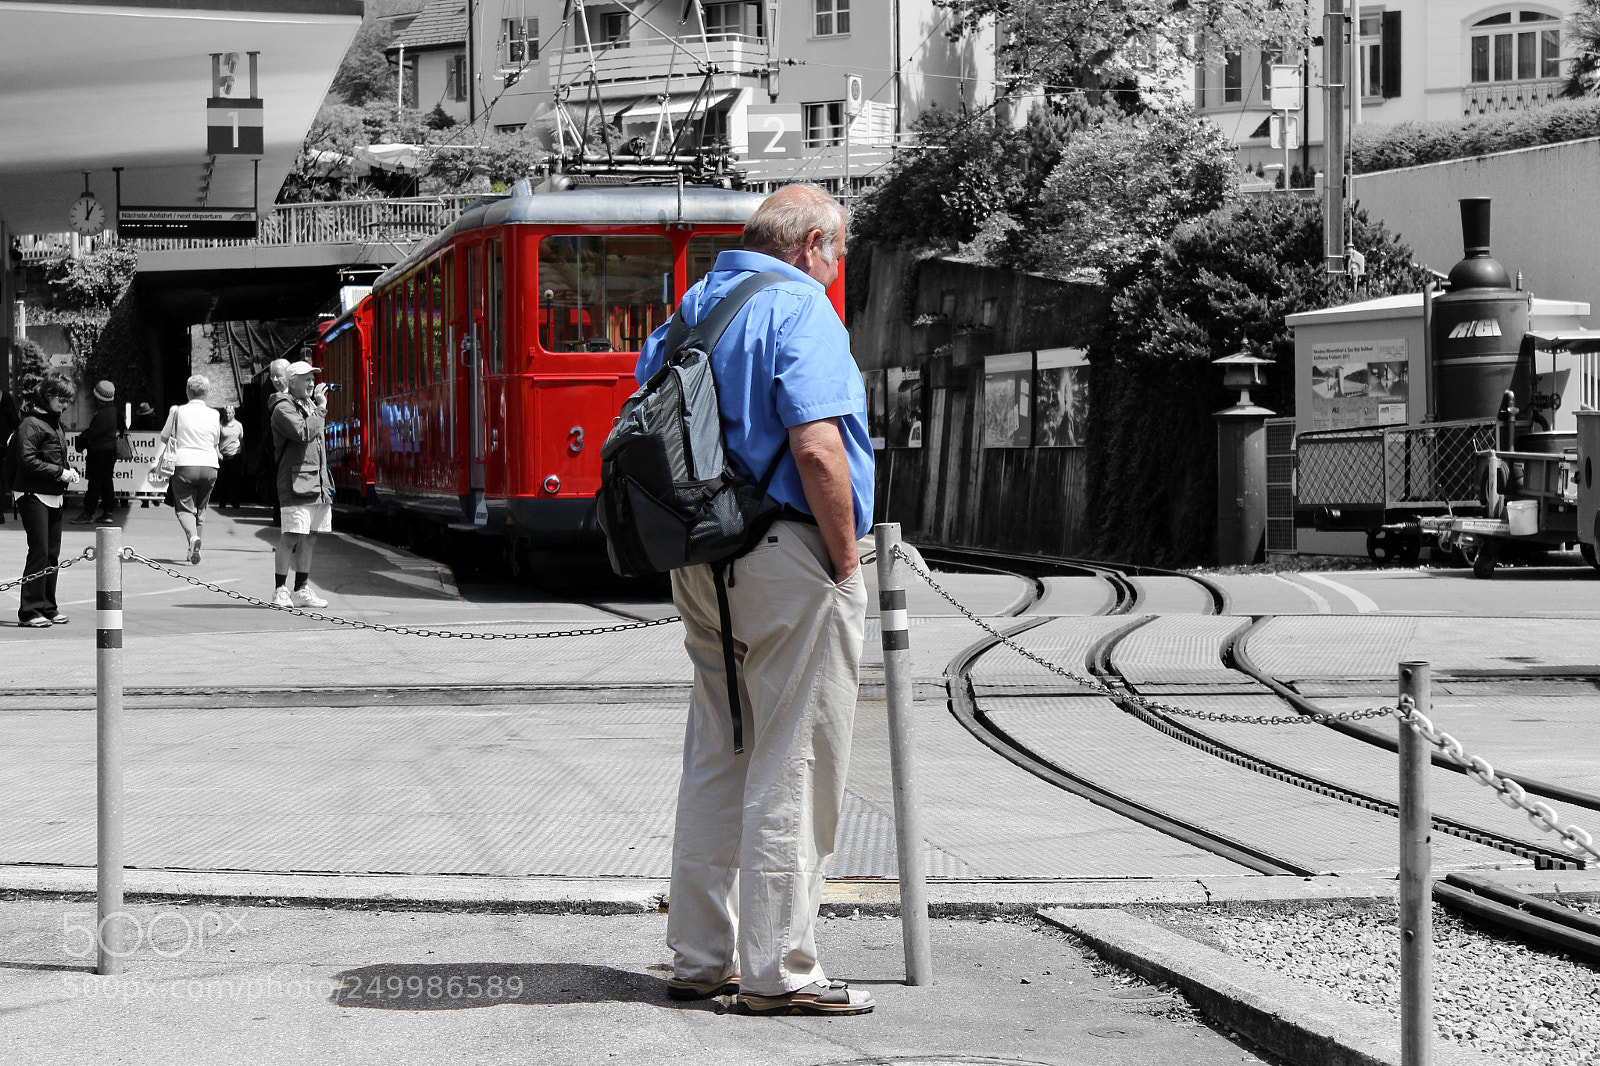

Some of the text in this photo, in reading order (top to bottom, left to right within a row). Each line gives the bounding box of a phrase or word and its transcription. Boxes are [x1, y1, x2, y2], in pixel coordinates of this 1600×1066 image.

[227, 112, 239, 148] 1
[763, 116, 786, 153] 2
[192, 213, 223, 221] departure
[1448, 319, 1502, 338] RIGI
[132, 438, 155, 448] und
[570, 426, 584, 452] 3
